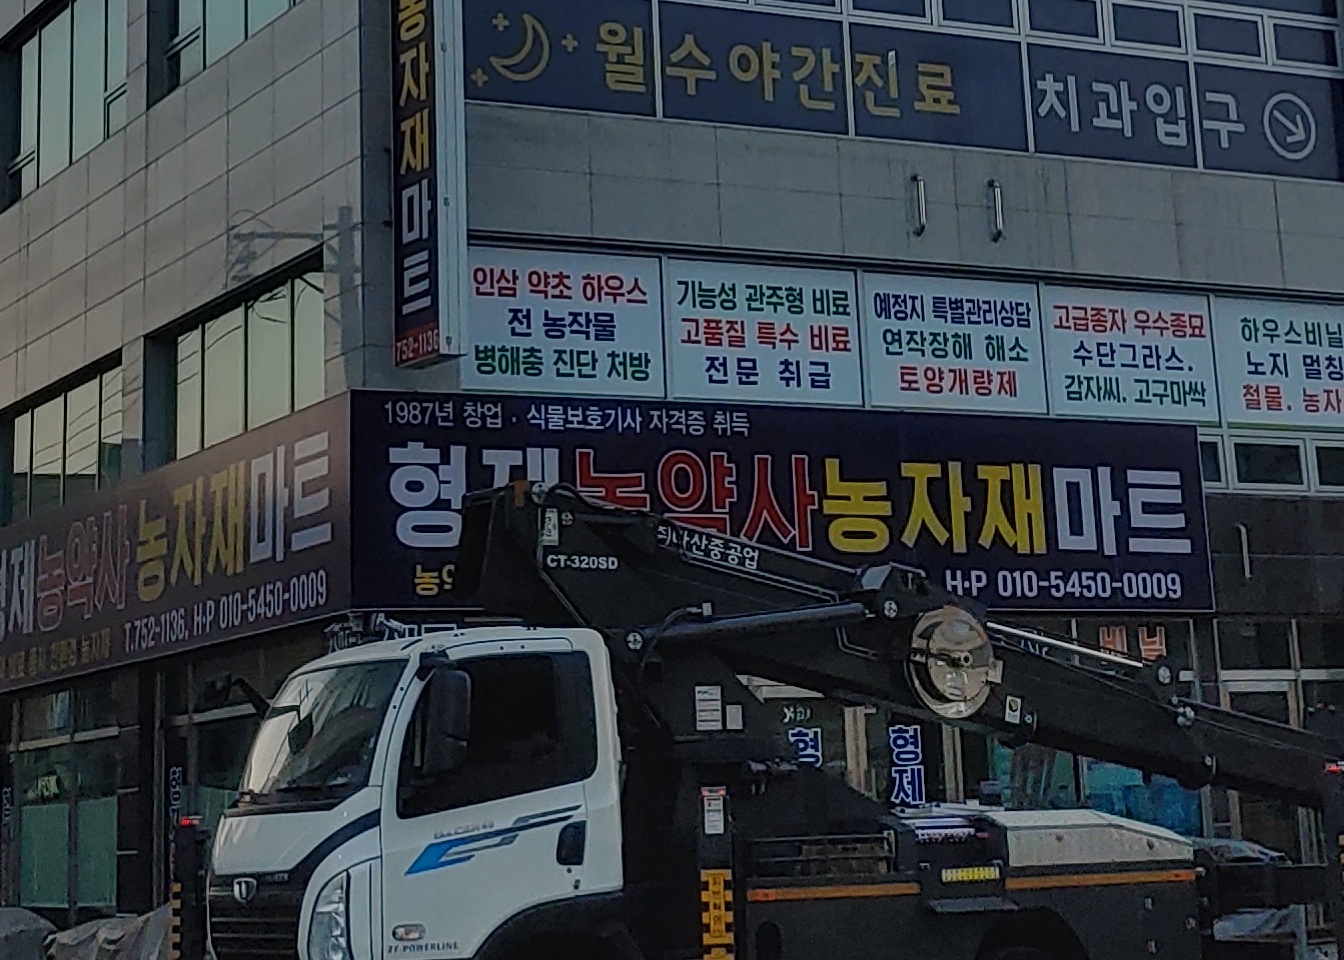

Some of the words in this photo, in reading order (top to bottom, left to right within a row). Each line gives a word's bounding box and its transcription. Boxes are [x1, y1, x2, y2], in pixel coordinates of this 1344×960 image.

[1036, 71, 1246, 150] 치과입구
[472, 266, 519, 298] 인삼
[528, 270, 573, 301] 약초
[581, 274, 649, 305] 하우스
[676, 277, 737, 310] 기능성
[744, 283, 804, 316] 관주형
[812, 287, 851, 318] 비료
[507, 308, 532, 339] 전
[542, 310, 617, 343] 농작물
[873, 292, 925, 324] 예정지
[931, 294, 1032, 330] 특별관리상담
[1053, 303, 1128, 336] 고급종자
[1134, 307, 1206, 340] 우수종묘
[396, 329, 439, 364] 752-1136
[680, 317, 748, 350] 고품질
[756, 321, 800, 351] 특수
[809, 323, 852, 355] 비료
[882, 328, 973, 361] 연작장해
[984, 333, 1029, 364] 해소
[473, 347, 544, 378] 병해충
[552, 350, 598, 380] 진단
[606, 351, 651, 382] 처방
[898, 365, 1018, 399] 토양개량제
[1245, 352, 1290, 380] 노지
[383, 400, 455, 430] 1987년
[462, 402, 504, 431] 창업
[526, 404, 643, 435] 식물보호기사
[648, 408, 707, 437] 자격증
[712, 411, 751, 439] 취득
[546, 553, 619, 572] CT-320SD
[219, 569, 328, 631] 010-5450-0009
[997, 569, 1183, 600] 010-5450-0009
